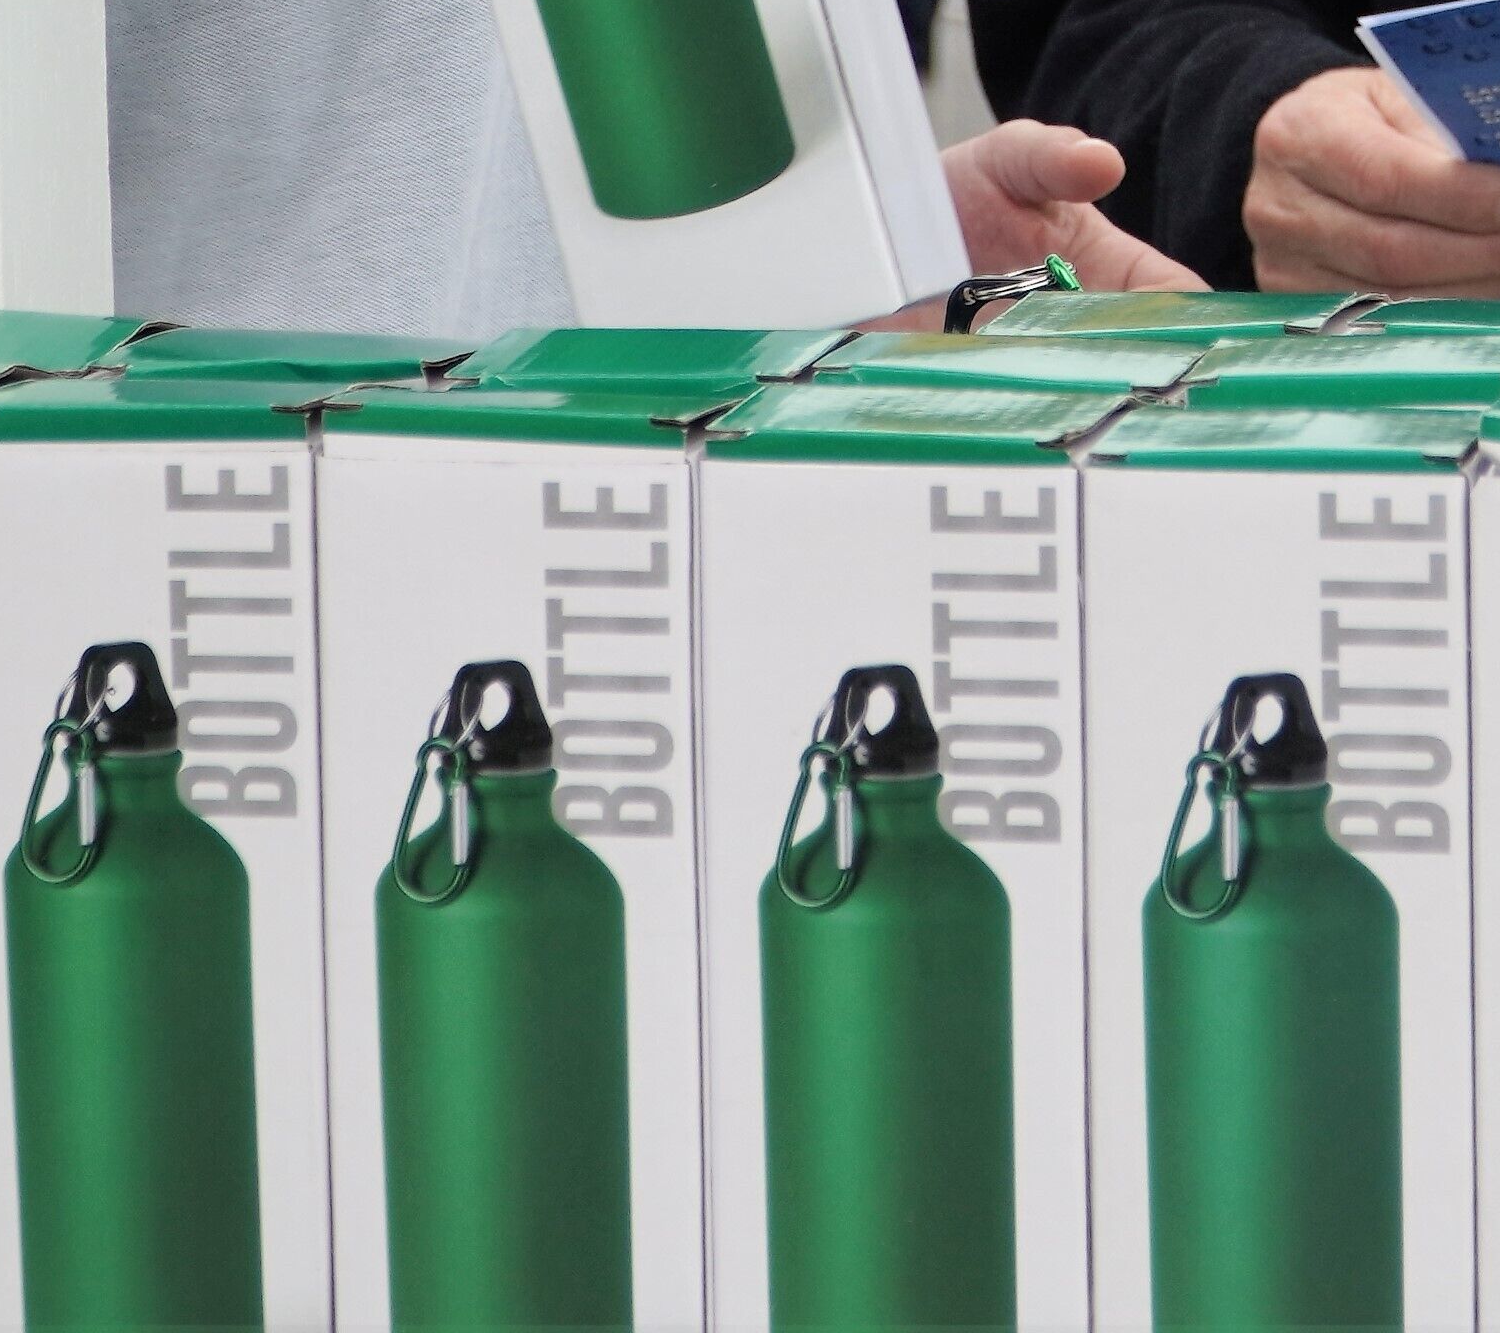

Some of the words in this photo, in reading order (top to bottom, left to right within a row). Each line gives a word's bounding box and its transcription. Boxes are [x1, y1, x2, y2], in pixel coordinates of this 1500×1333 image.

[165, 464, 298, 817] BOTTLE
[543, 481, 674, 838] BOTTLE
[930, 484, 1062, 843] BOTTLE
[1319, 492, 1452, 854] BOTTLE
